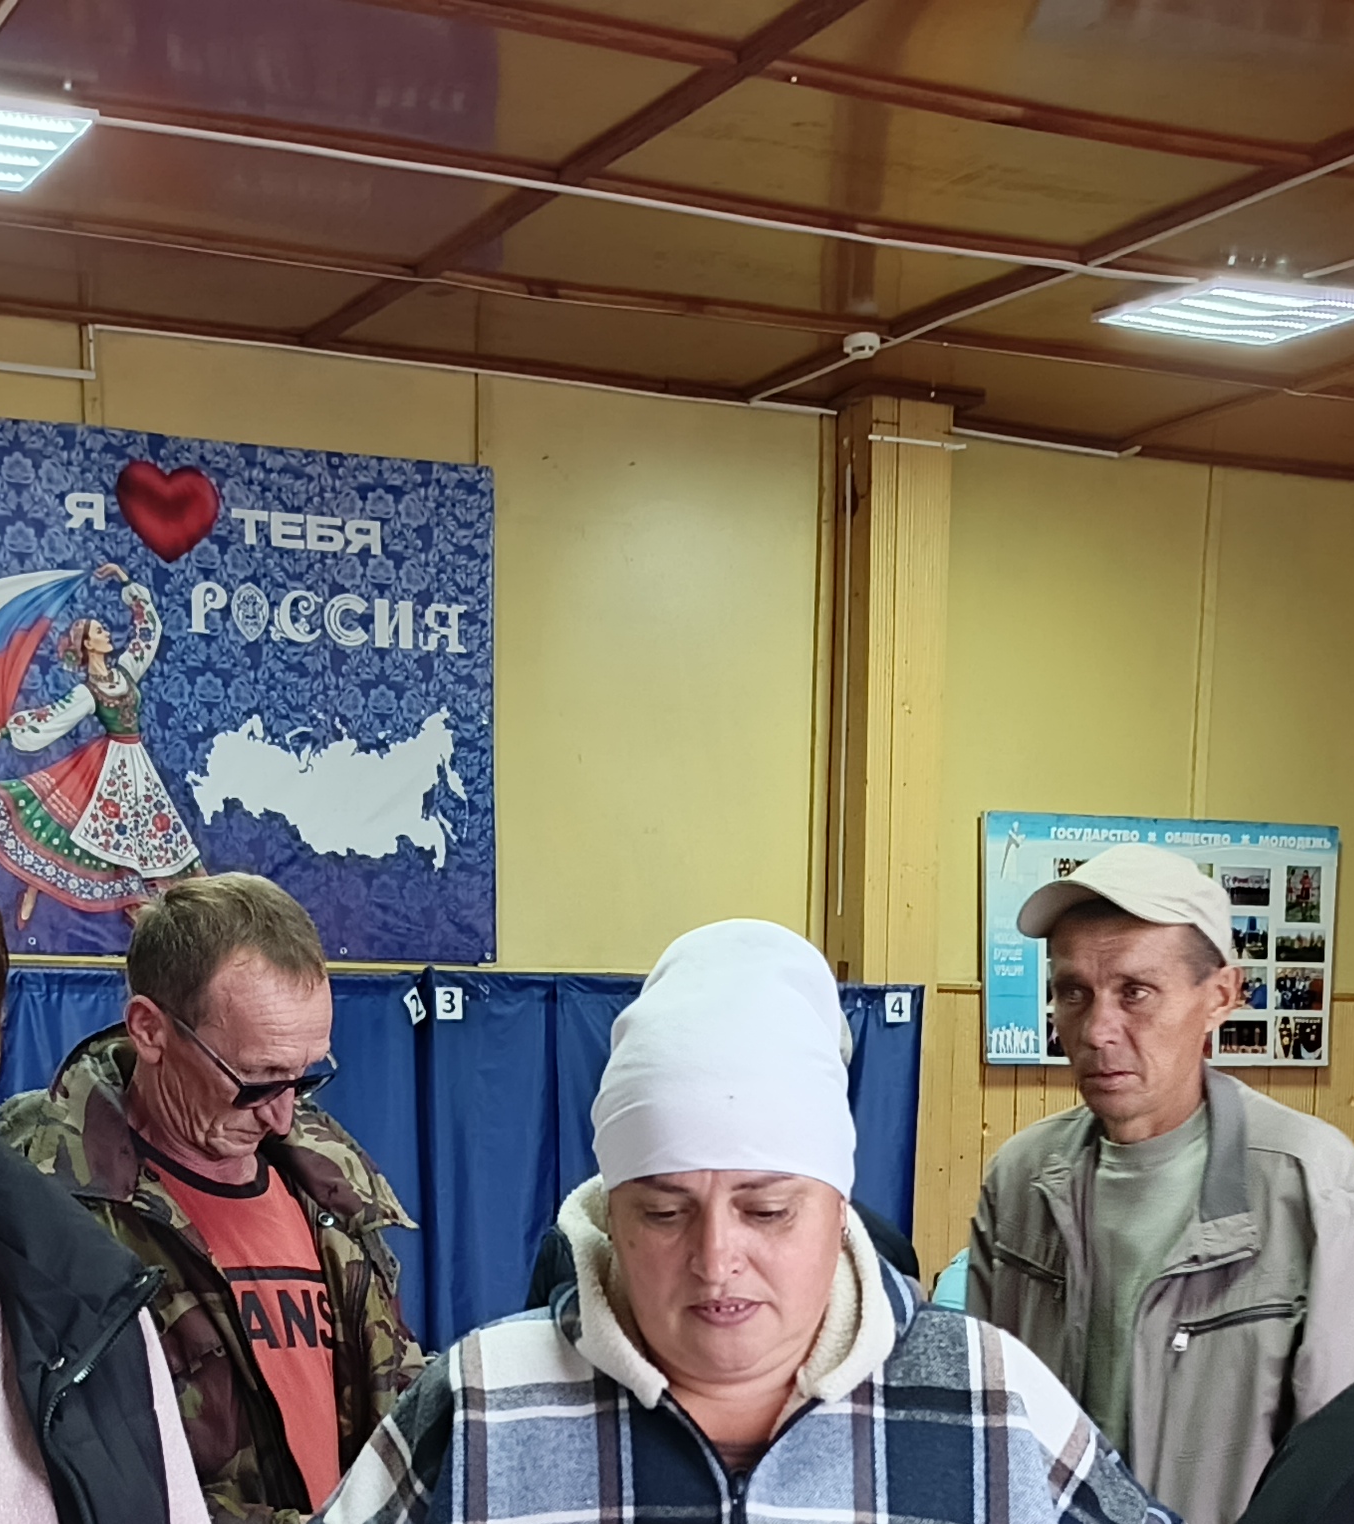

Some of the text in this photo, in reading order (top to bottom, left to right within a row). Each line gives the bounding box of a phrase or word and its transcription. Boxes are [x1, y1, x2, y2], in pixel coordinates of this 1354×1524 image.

[64, 490, 383, 556] Я ТЕБЯ
[185, 580, 468, 654] РОССИЯ
[1049, 826, 1140, 843] ГОСУДАРСТВО
[1164, 831, 1231, 846] ОБЩЕСТВО
[409, 993, 424, 1018] 2
[442, 992, 456, 1013] 3
[890, 995, 905, 1017] 4
[239, 1288, 335, 1350] ANS
